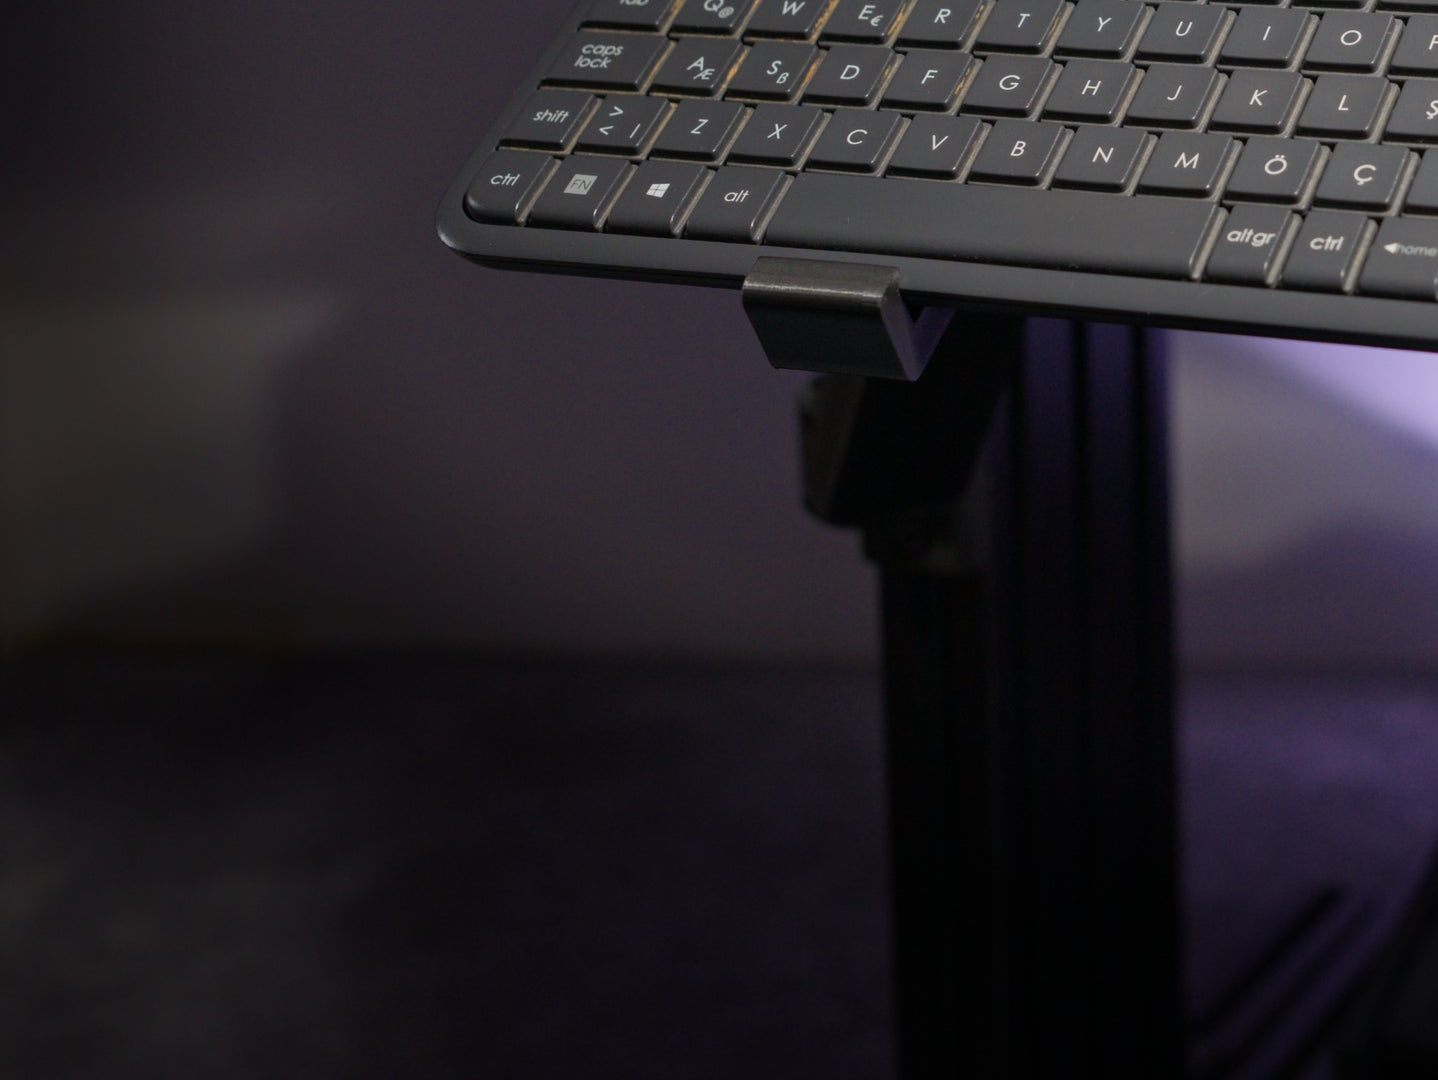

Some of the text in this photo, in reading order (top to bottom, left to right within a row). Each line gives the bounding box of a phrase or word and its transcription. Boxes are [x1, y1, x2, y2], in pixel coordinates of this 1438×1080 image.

[783, 1, 805, 15] W
[858, 5, 876, 21] E
[871, 15, 883, 26] €
[934, 9, 951, 23] R
[1018, 14, 1030, 27] T
[1098, 17, 1111, 31] Y
[1176, 21, 1192, 36] U
[1341, 30, 1361, 45] O
[580, 45, 623, 59] caps
[575, 54, 611, 68] lock
[687, 55, 705, 72] A
[767, 61, 783, 77] S
[840, 65, 859, 79] D
[921, 70, 938, 84] F
[999, 75, 1020, 90] G
[1082, 80, 1101, 95] H
[1167, 85, 1182, 100] J
[1250, 90, 1267, 105] K
[1338, 95, 1348, 110] L
[533, 110, 568, 122] shift
[691, 119, 708, 134] Z
[768, 124, 787, 139] X
[847, 130, 867, 144] C
[933, 135, 948, 150] V
[1011, 141, 1026, 156] B
[1092, 147, 1113, 162] N
[1174, 153, 1199, 168] M
[1265, 155, 1287, 175] Ö
[491, 174, 520, 185] ctrl
[1354, 165, 1376, 185] Ç
[725, 190, 749, 202] alt
[1227, 229, 1275, 247] altgr
[1310, 236, 1344, 250] ctrl
[1398, 243, 1438, 258] home
